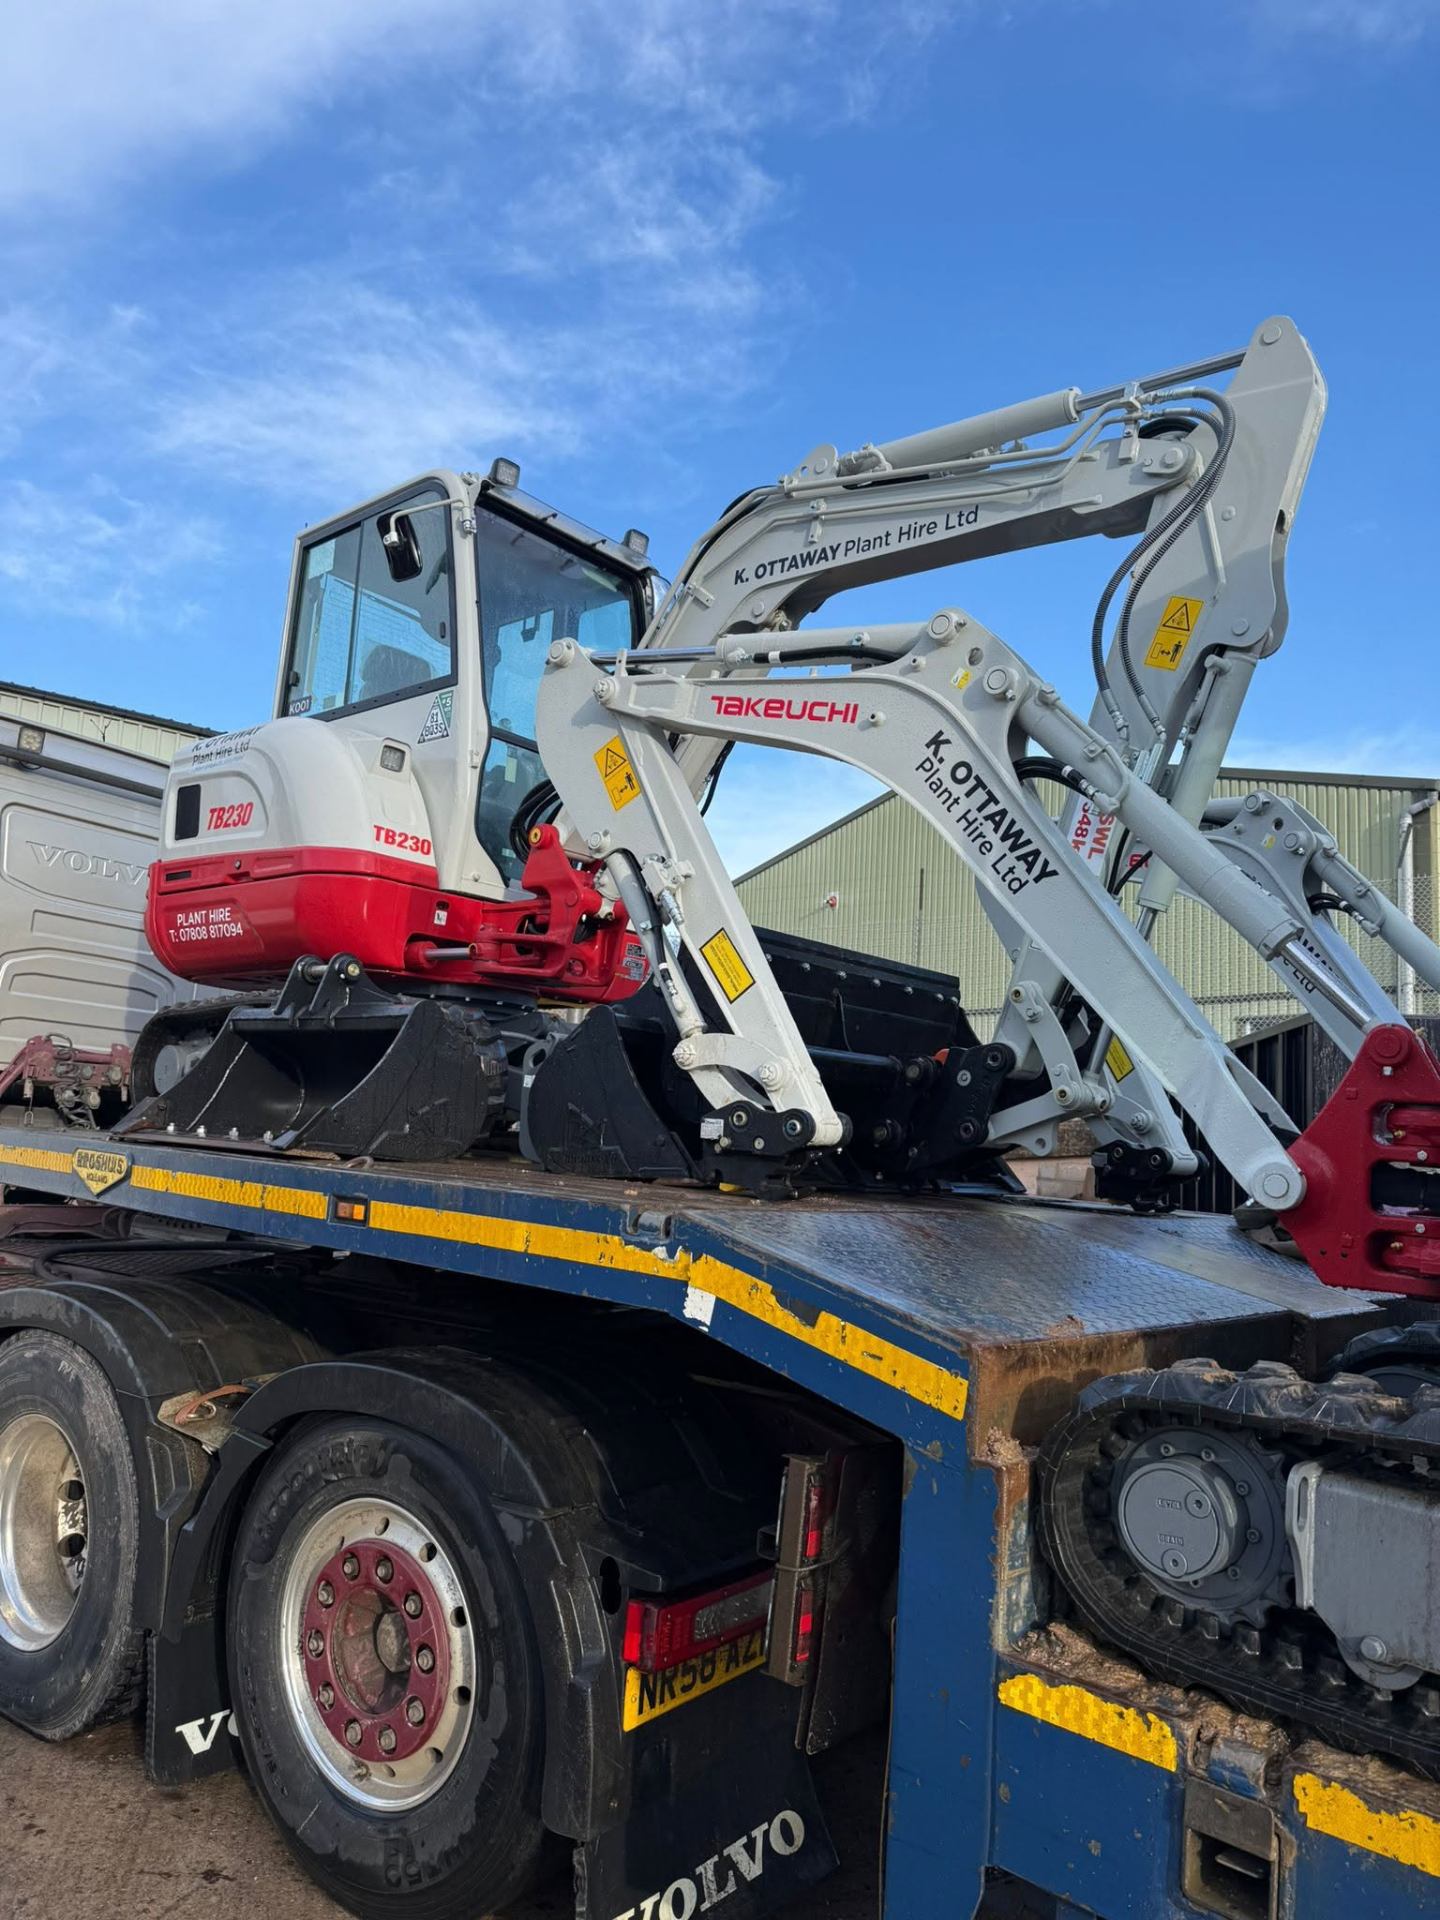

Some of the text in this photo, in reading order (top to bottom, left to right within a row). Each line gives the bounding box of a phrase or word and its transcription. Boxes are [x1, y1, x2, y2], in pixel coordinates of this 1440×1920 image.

[734, 505, 980, 585] K. OTTAWAY Plant Hire Ltd
[192, 752, 213, 766] Plant
[215, 746, 233, 760] Hire
[234, 739, 251, 753] Ltd
[207, 801, 254, 831] TB230
[915, 756, 1029, 895] Plant Hire Ltd
[925, 729, 1060, 884] K. OTTAWAY
[373, 824, 432, 856] TB230
[1087, 810, 1117, 860] SWL
[25, 840, 150, 885] VOLV
[177, 907, 231, 927] PLANT HIRE
[179, 925, 208, 941] 07808
[209, 921, 243, 938] 817094
